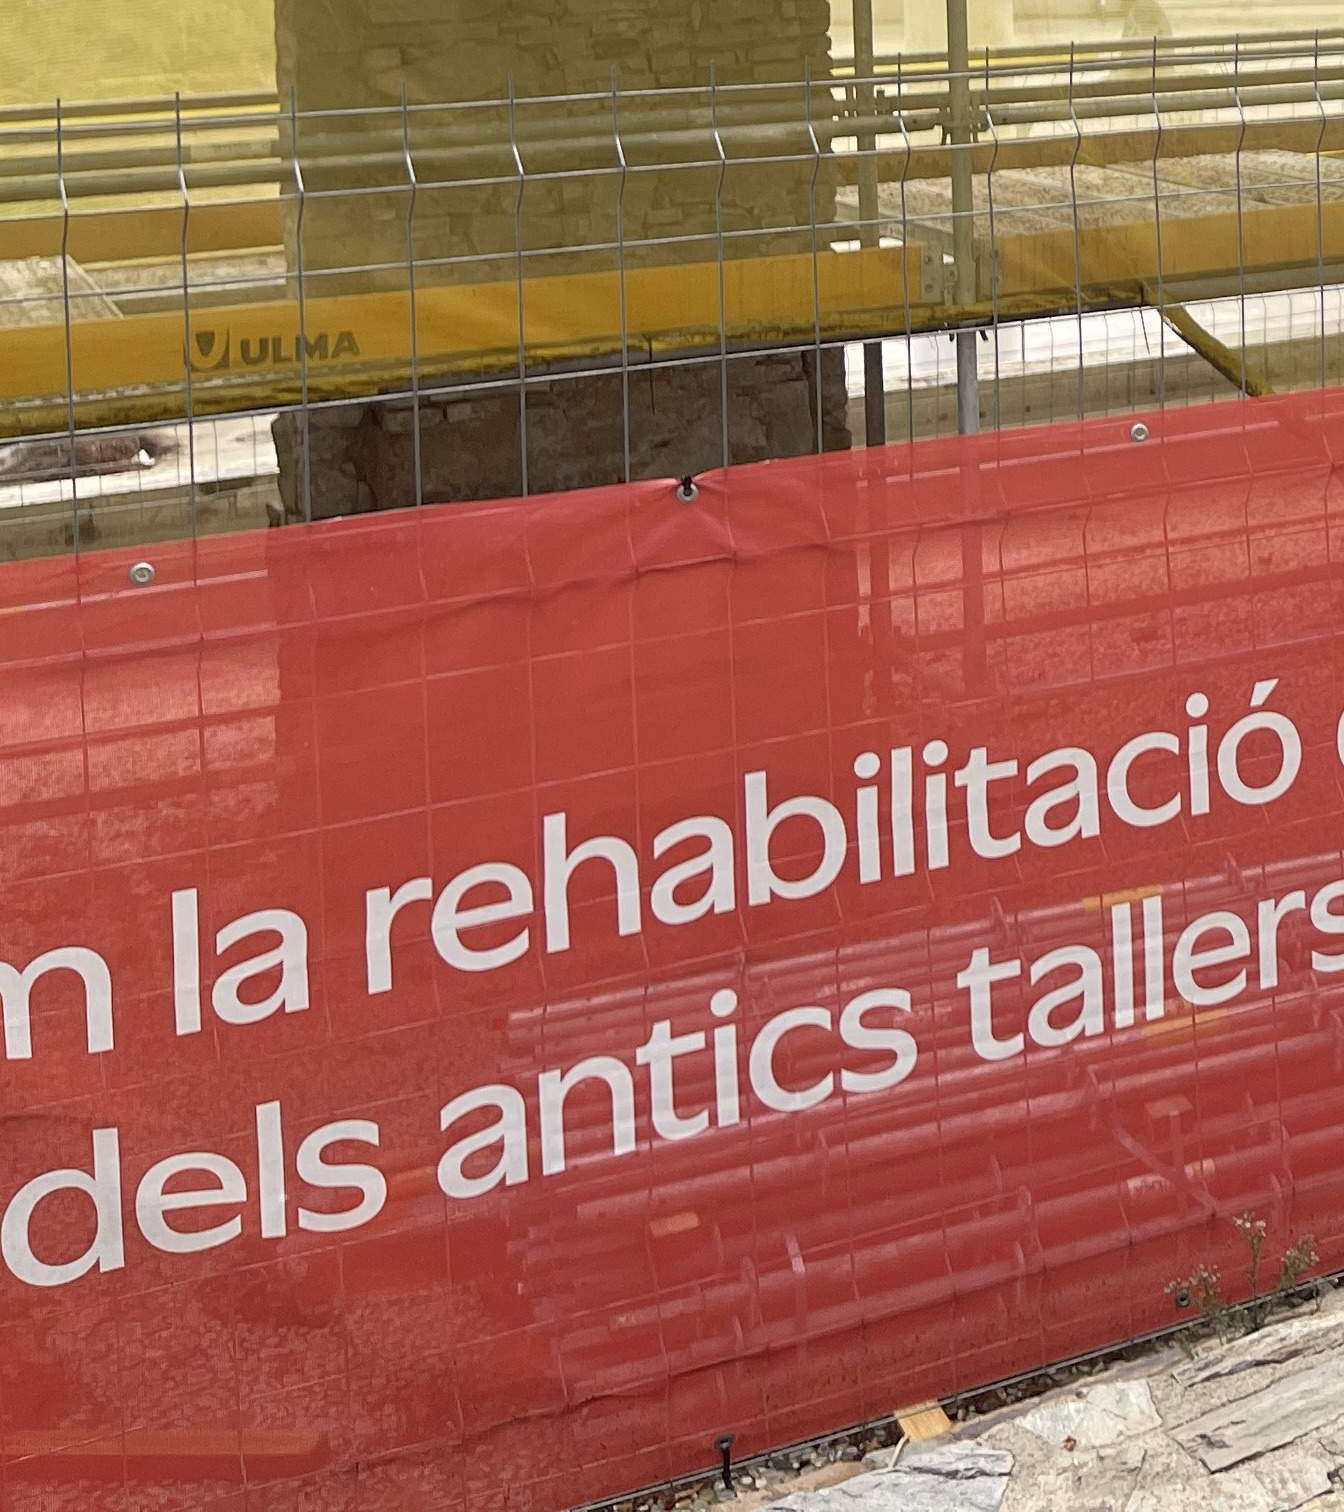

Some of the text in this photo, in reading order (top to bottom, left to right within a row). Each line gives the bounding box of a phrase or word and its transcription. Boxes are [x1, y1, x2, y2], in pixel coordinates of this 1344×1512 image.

[239, 330, 362, 367] ULMA
[171, 888, 309, 1036] la
[365, 678, 1301, 994] rehabilitació
[0, 1101, 387, 1287] dels
[436, 989, 918, 1199] antics
